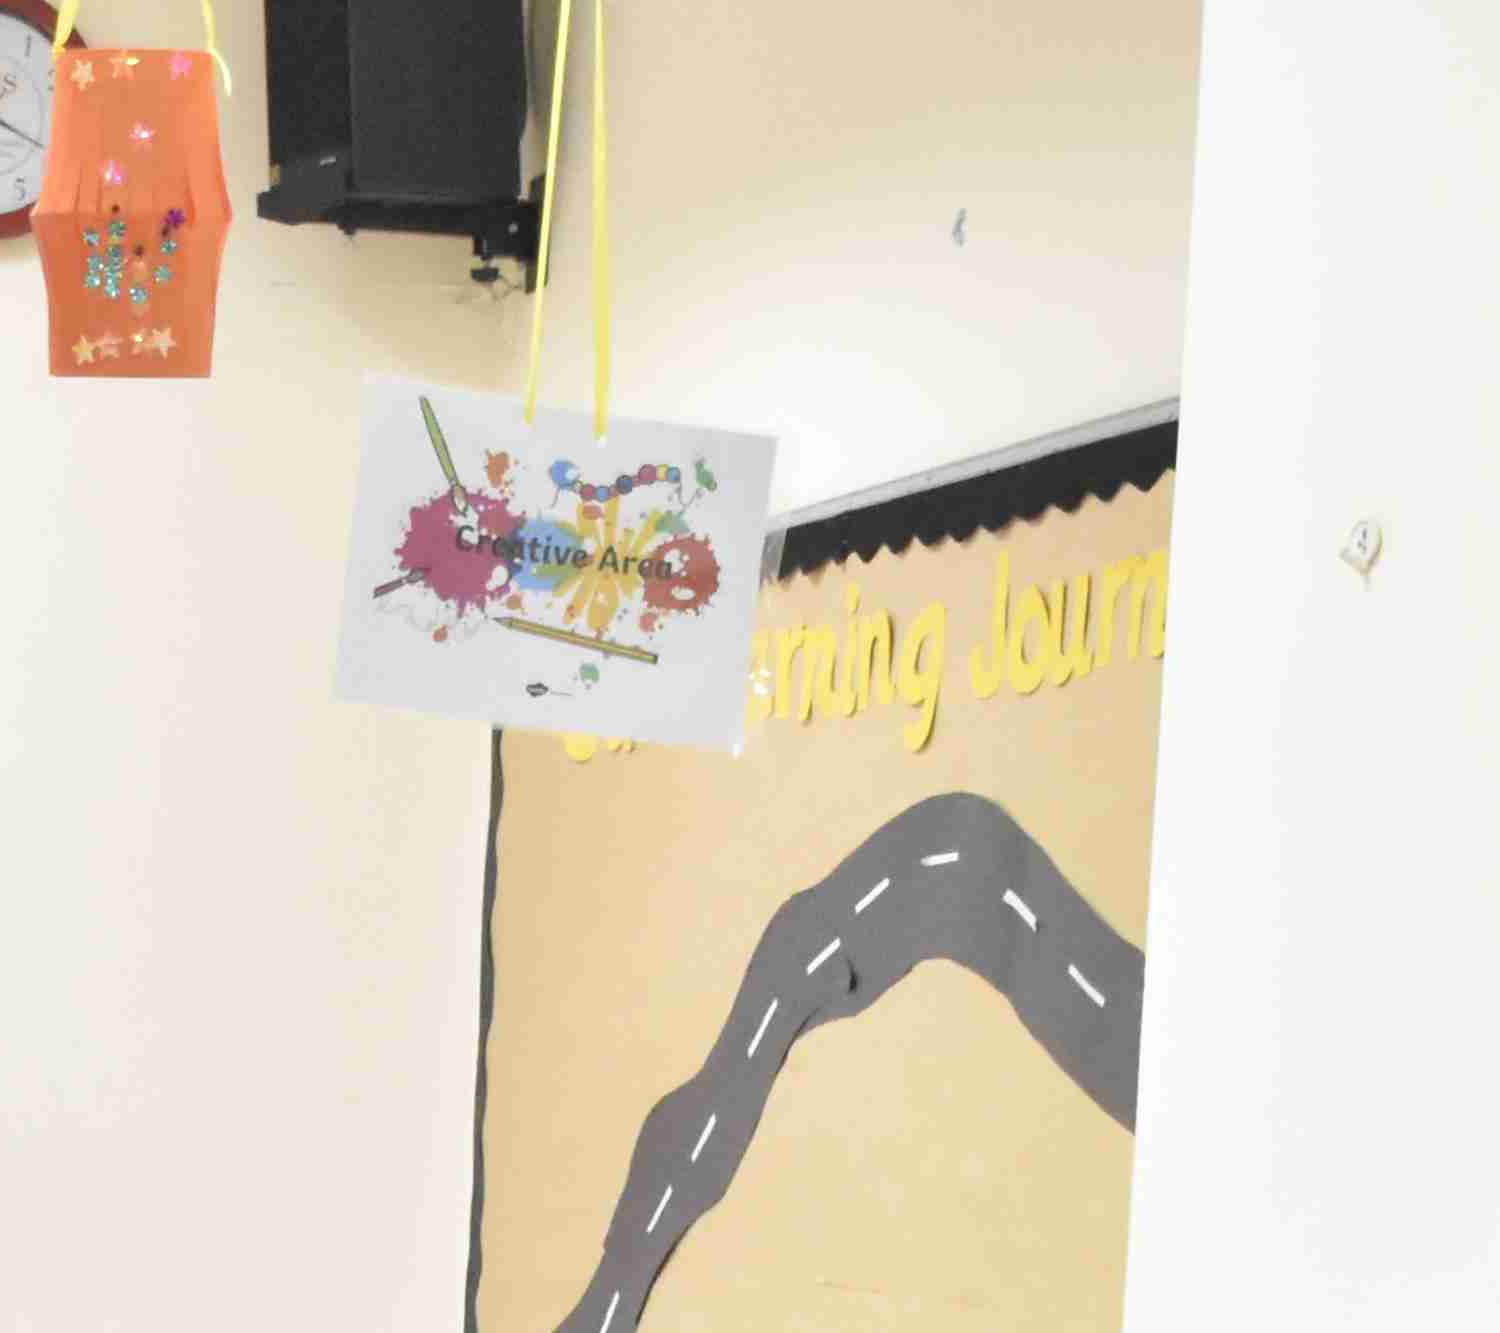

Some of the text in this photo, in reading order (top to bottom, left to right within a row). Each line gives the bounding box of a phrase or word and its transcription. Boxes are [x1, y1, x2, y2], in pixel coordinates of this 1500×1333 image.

[13, 176, 26, 202] 5
[455, 523, 674, 581] Creative Area
